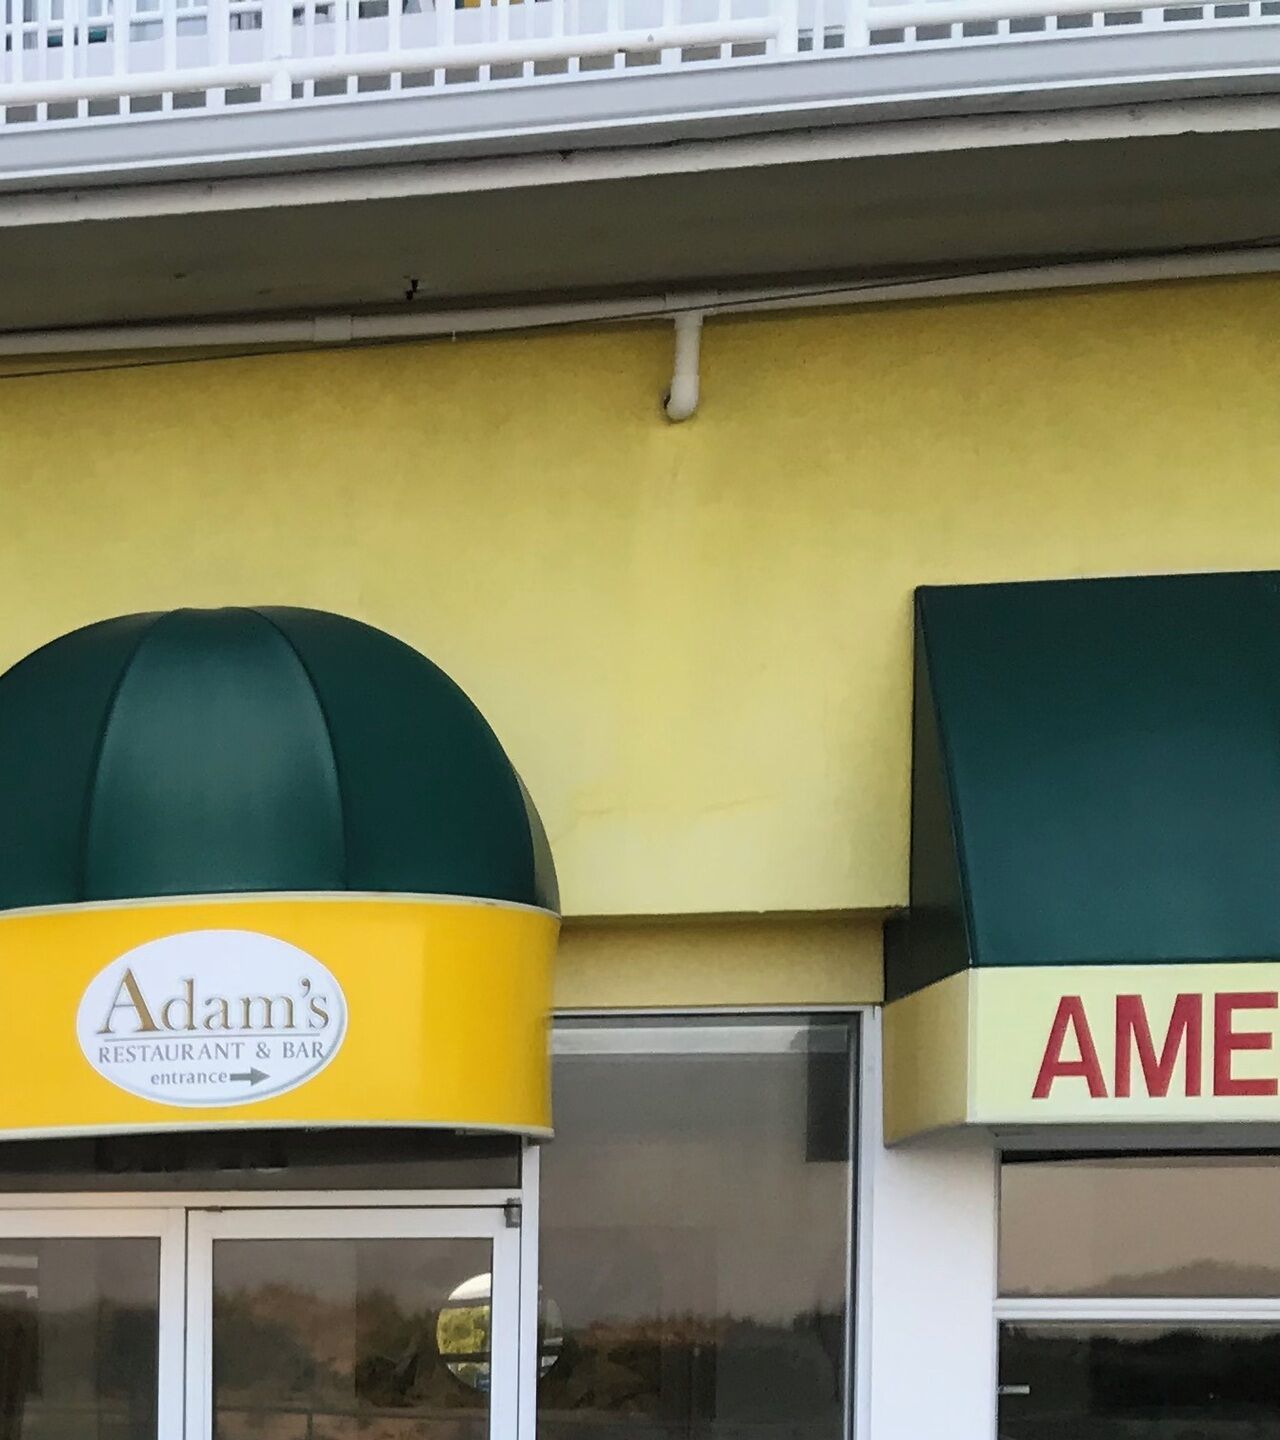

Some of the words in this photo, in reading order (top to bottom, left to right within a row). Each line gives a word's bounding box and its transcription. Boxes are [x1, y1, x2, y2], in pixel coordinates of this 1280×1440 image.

[96, 967, 330, 1034] Adam's
[98, 1042, 246, 1064] RESTAURANT
[255, 1041, 271, 1060] &
[282, 1040, 326, 1059] BAR
[1031, 991, 1279, 1099] AME
[150, 1071, 228, 1086] entrance
